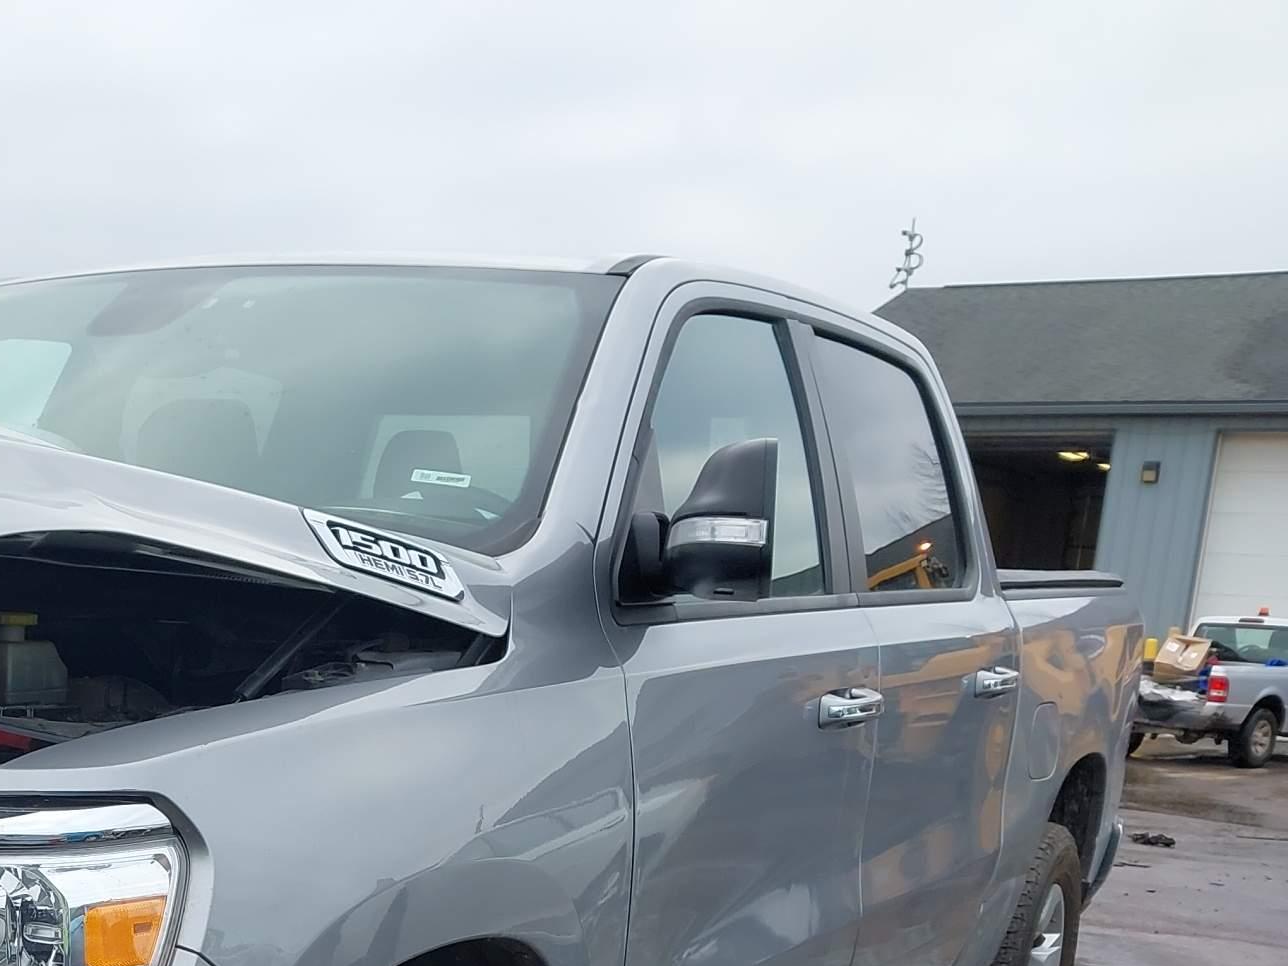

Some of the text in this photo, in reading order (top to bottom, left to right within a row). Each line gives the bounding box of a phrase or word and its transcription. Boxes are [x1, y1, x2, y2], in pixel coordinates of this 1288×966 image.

[330, 526, 437, 574] 1500
[359, 554, 442, 590] HEMI 5.7L
